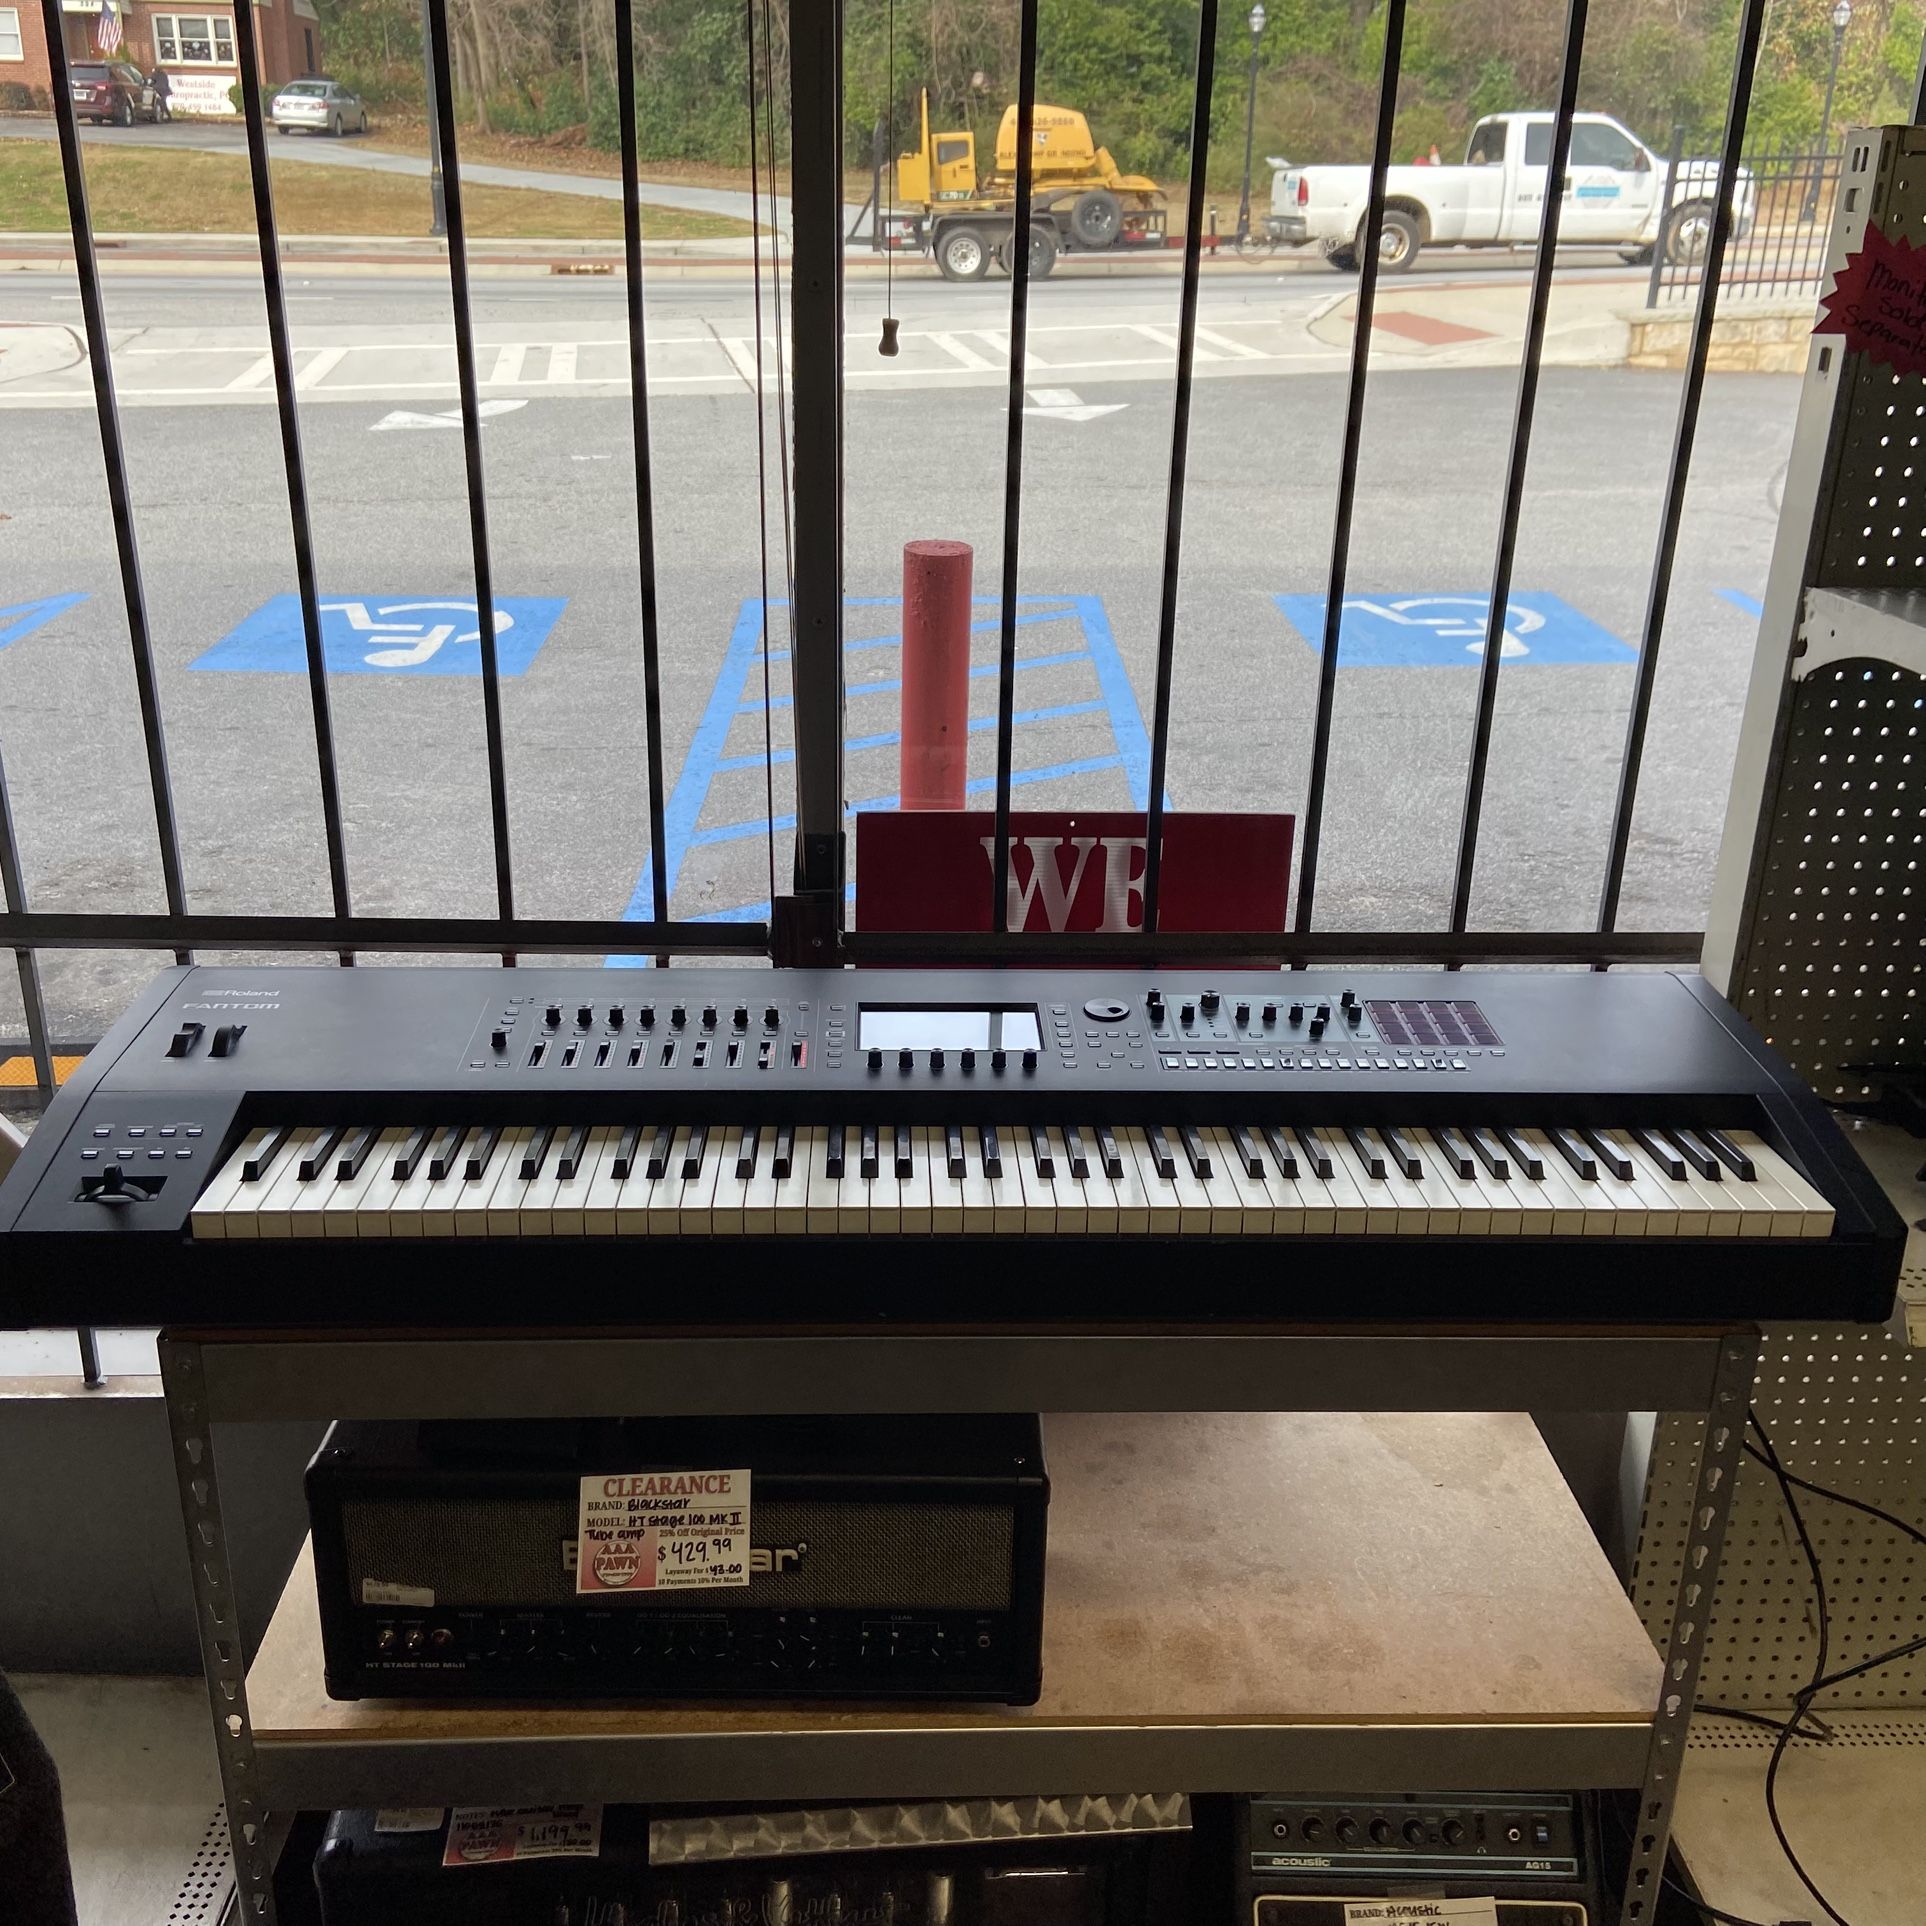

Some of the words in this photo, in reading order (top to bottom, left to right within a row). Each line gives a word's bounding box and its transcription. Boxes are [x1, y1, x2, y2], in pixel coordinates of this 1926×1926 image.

[176, 79, 216, 89] Westside
[979, 836, 1164, 934] WE
[224, 988, 281, 997] Roland
[603, 1475, 731, 1497] CLEARANCE
[587, 1501, 625, 1511] BRAND:
[627, 1498, 691, 1512] Blackstar
[586, 1517, 625, 1528] MODEL:
[628, 1516, 645, 1527] HT
[688, 1513, 705, 1526] 100
[730, 1511, 743, 1525] II
[617, 1528, 646, 1542] amp
[659, 1529, 675, 1538] 25%
[677, 1528, 690, 1537] Off
[691, 1527, 723, 1539] Original
[724, 1527, 745, 1536] Price
[600, 1543, 635, 1555] AAA
[595, 1556, 640, 1571] PAWN
[665, 1568, 693, 1577] Layaway
[694, 1567, 704, 1575] For
[666, 1577, 697, 1586] Payments
[711, 1576, 722, 1584] Per
[723, 1576, 744, 1584] Month
[1271, 1857, 1331, 1867] acoustic
[1525, 1861, 1552, 1870] AG15
[1349, 1908, 1384, 1919] BRAND:
